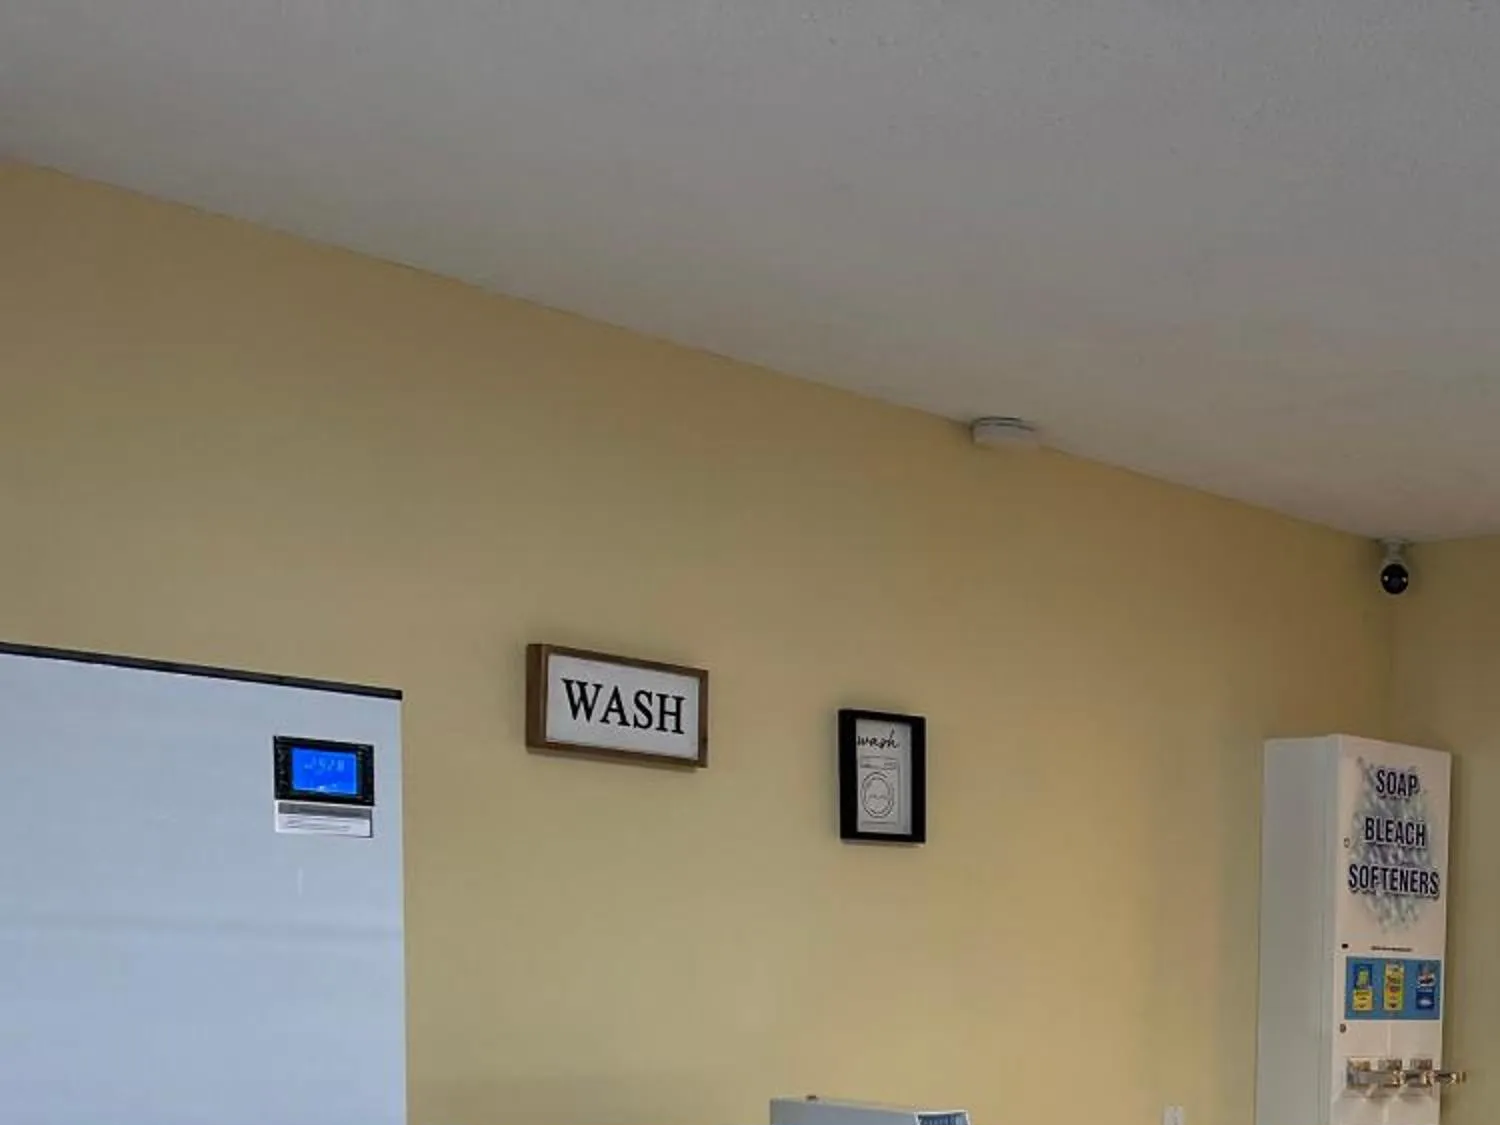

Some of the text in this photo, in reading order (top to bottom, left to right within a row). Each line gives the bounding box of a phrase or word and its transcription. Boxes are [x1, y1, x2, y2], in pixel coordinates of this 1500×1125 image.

[562, 679, 685, 734] WASH
[857, 727, 900, 749] wash
[1375, 769, 1419, 796] SOAP
[1364, 817, 1426, 846] BLEACH
[1348, 863, 1439, 896] SOFTENERS
